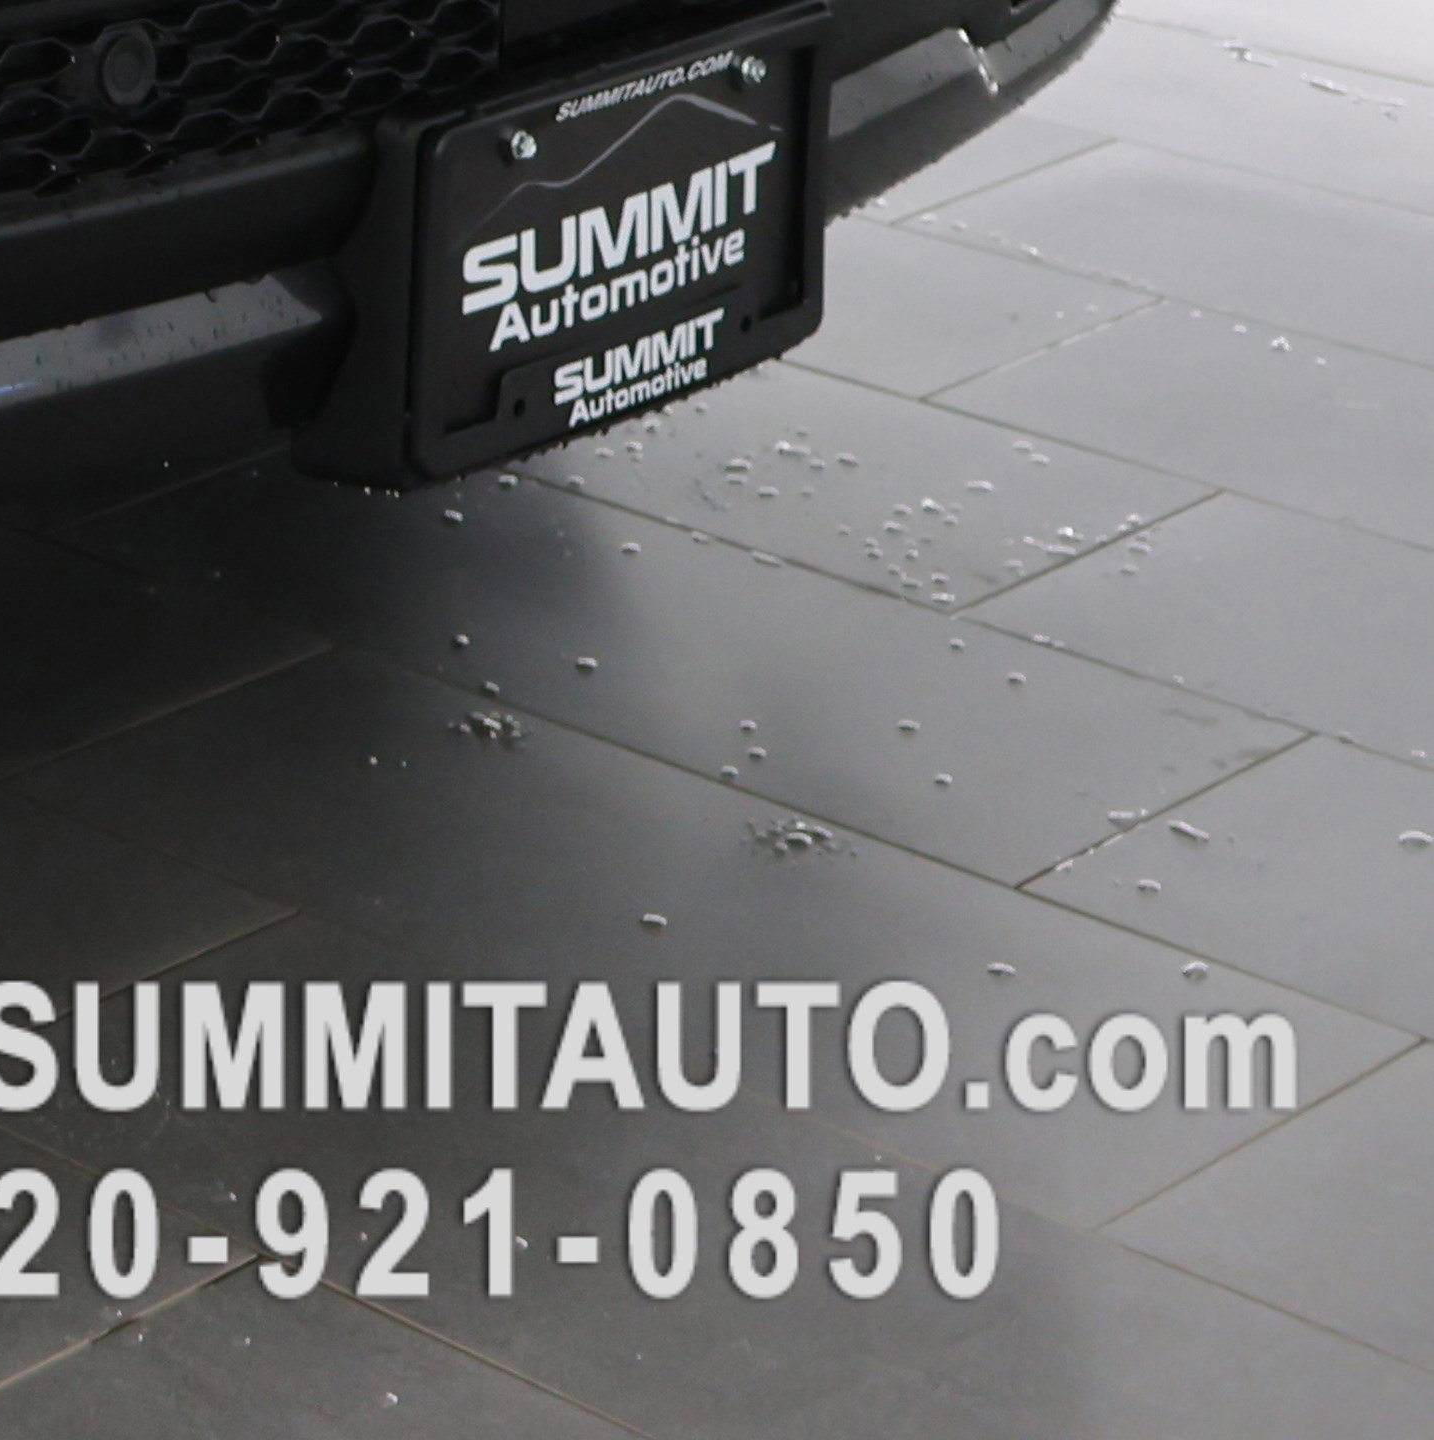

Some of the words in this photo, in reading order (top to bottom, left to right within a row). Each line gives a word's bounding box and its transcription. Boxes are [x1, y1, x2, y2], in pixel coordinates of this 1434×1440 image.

[555, 49, 735, 123] SUMMITAUTO.COM
[461, 140, 777, 316] SUMMIT
[489, 227, 746, 352] Automotive
[553, 307, 725, 406] SUMMIT
[568, 356, 709, 428] Automotive
